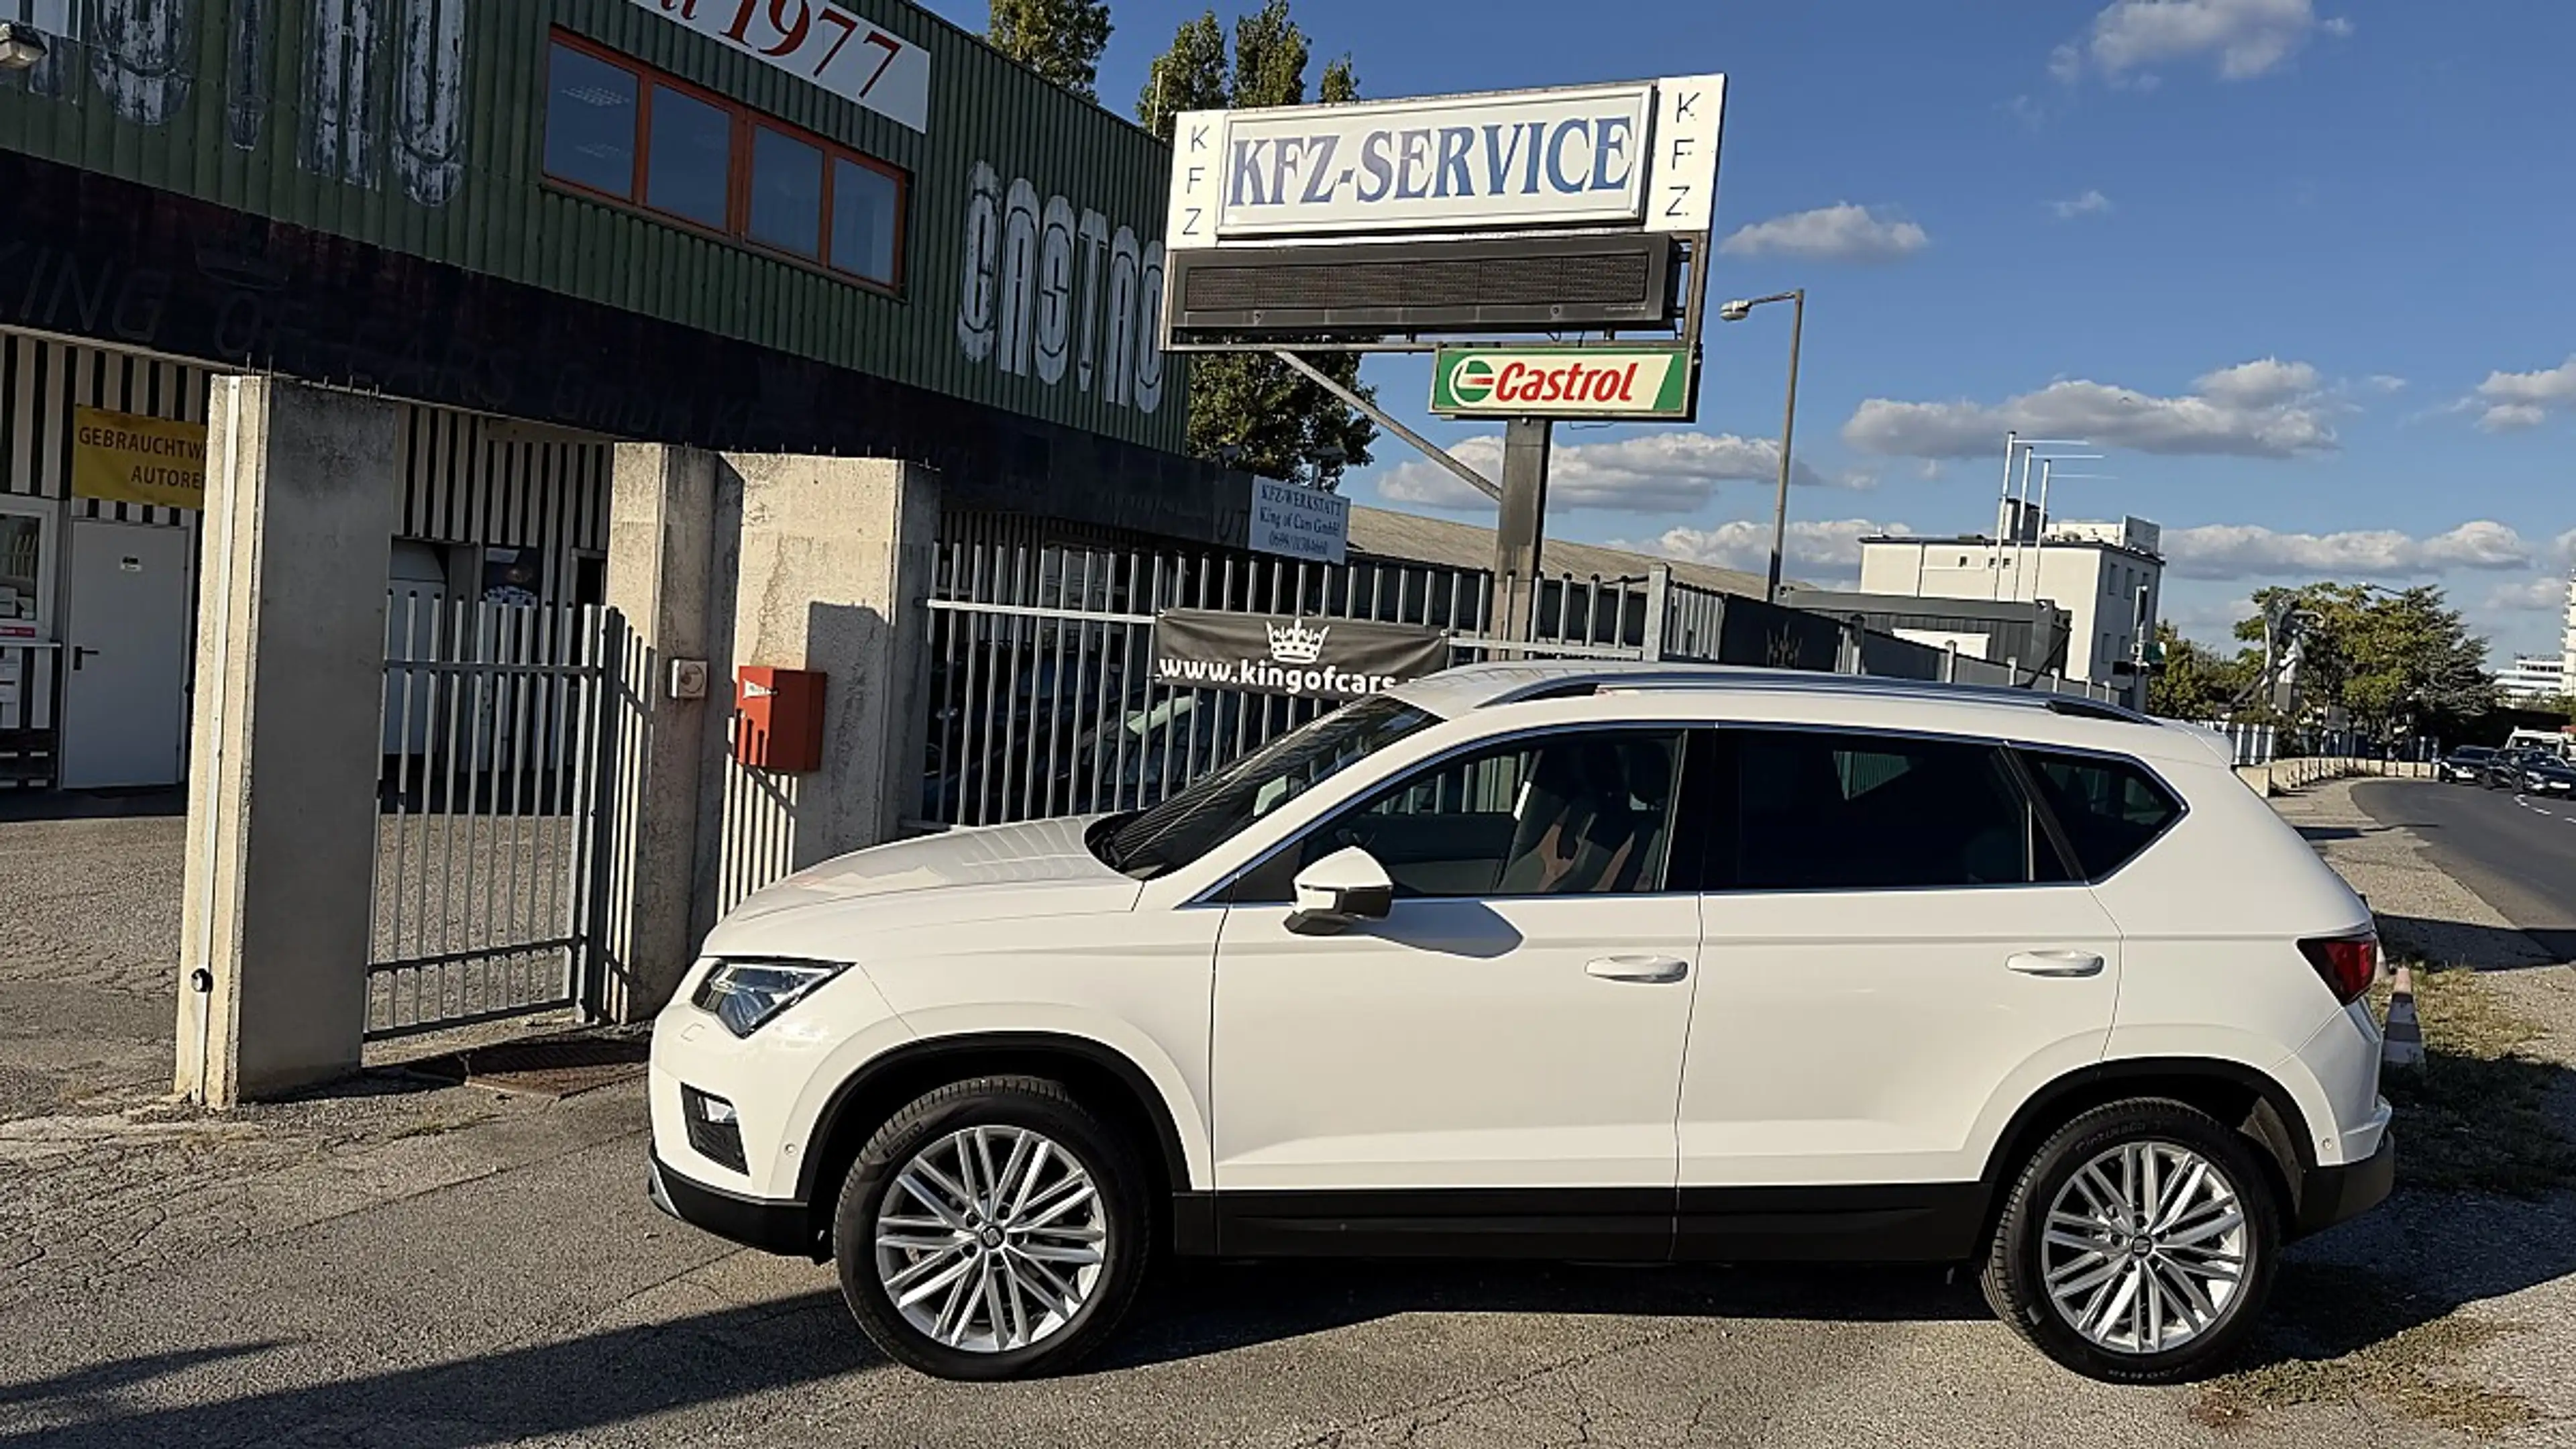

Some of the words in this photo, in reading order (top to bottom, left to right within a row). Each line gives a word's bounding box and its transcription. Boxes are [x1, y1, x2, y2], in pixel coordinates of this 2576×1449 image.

[1228, 116, 1631, 208] KFZ-SERVICE
[1495, 362, 1639, 402] Castrol
[79, 427, 207, 462] GEBRAUCHTW
[131, 466, 205, 490] AUTORE
[1159, 657, 1417, 695] www.kingofcars
